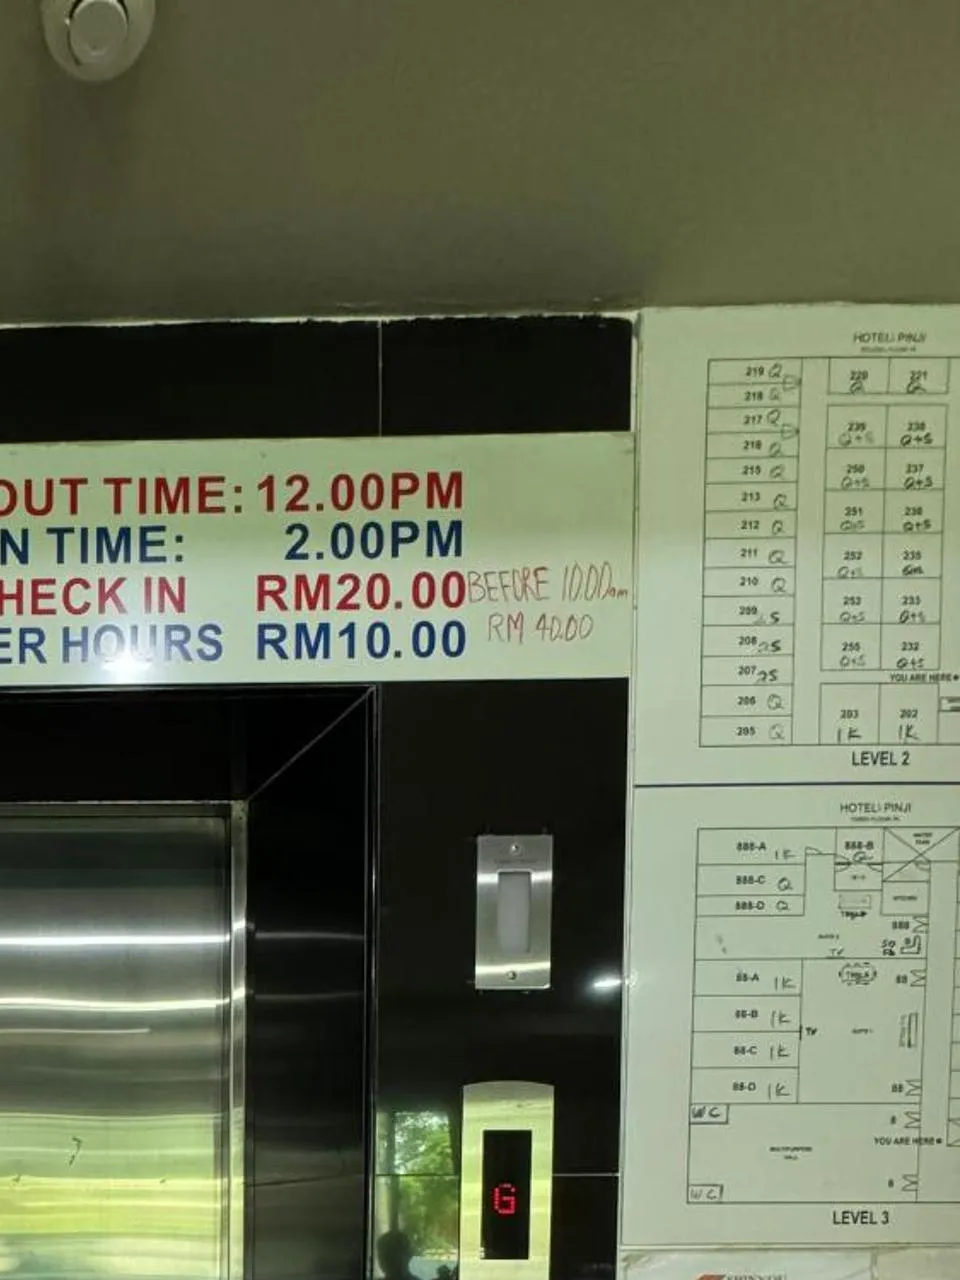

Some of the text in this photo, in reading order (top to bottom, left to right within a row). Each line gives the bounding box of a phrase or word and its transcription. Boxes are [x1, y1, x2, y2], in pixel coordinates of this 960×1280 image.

[103, 475, 243, 516] TIME:
[256, 471, 464, 513] 12.00PM
[46, 524, 184, 565] TIME:
[284, 519, 464, 561] 2.00PM
[144, 576, 187, 615] IN
[256, 571, 467, 613] RM20.00
[62, 623, 224, 664] HOURS
[256, 620, 467, 661] RM10.00
[488, 611, 525, 645] RM
[890, 672, 952, 682] YOU ARE HERE
[851, 750, 910, 766] LEVEL 2
[874, 1136, 935, 1146] YOU ARE HERE
[494, 1183, 517, 1215] G
[833, 1210, 890, 1225] LEVEL 3
